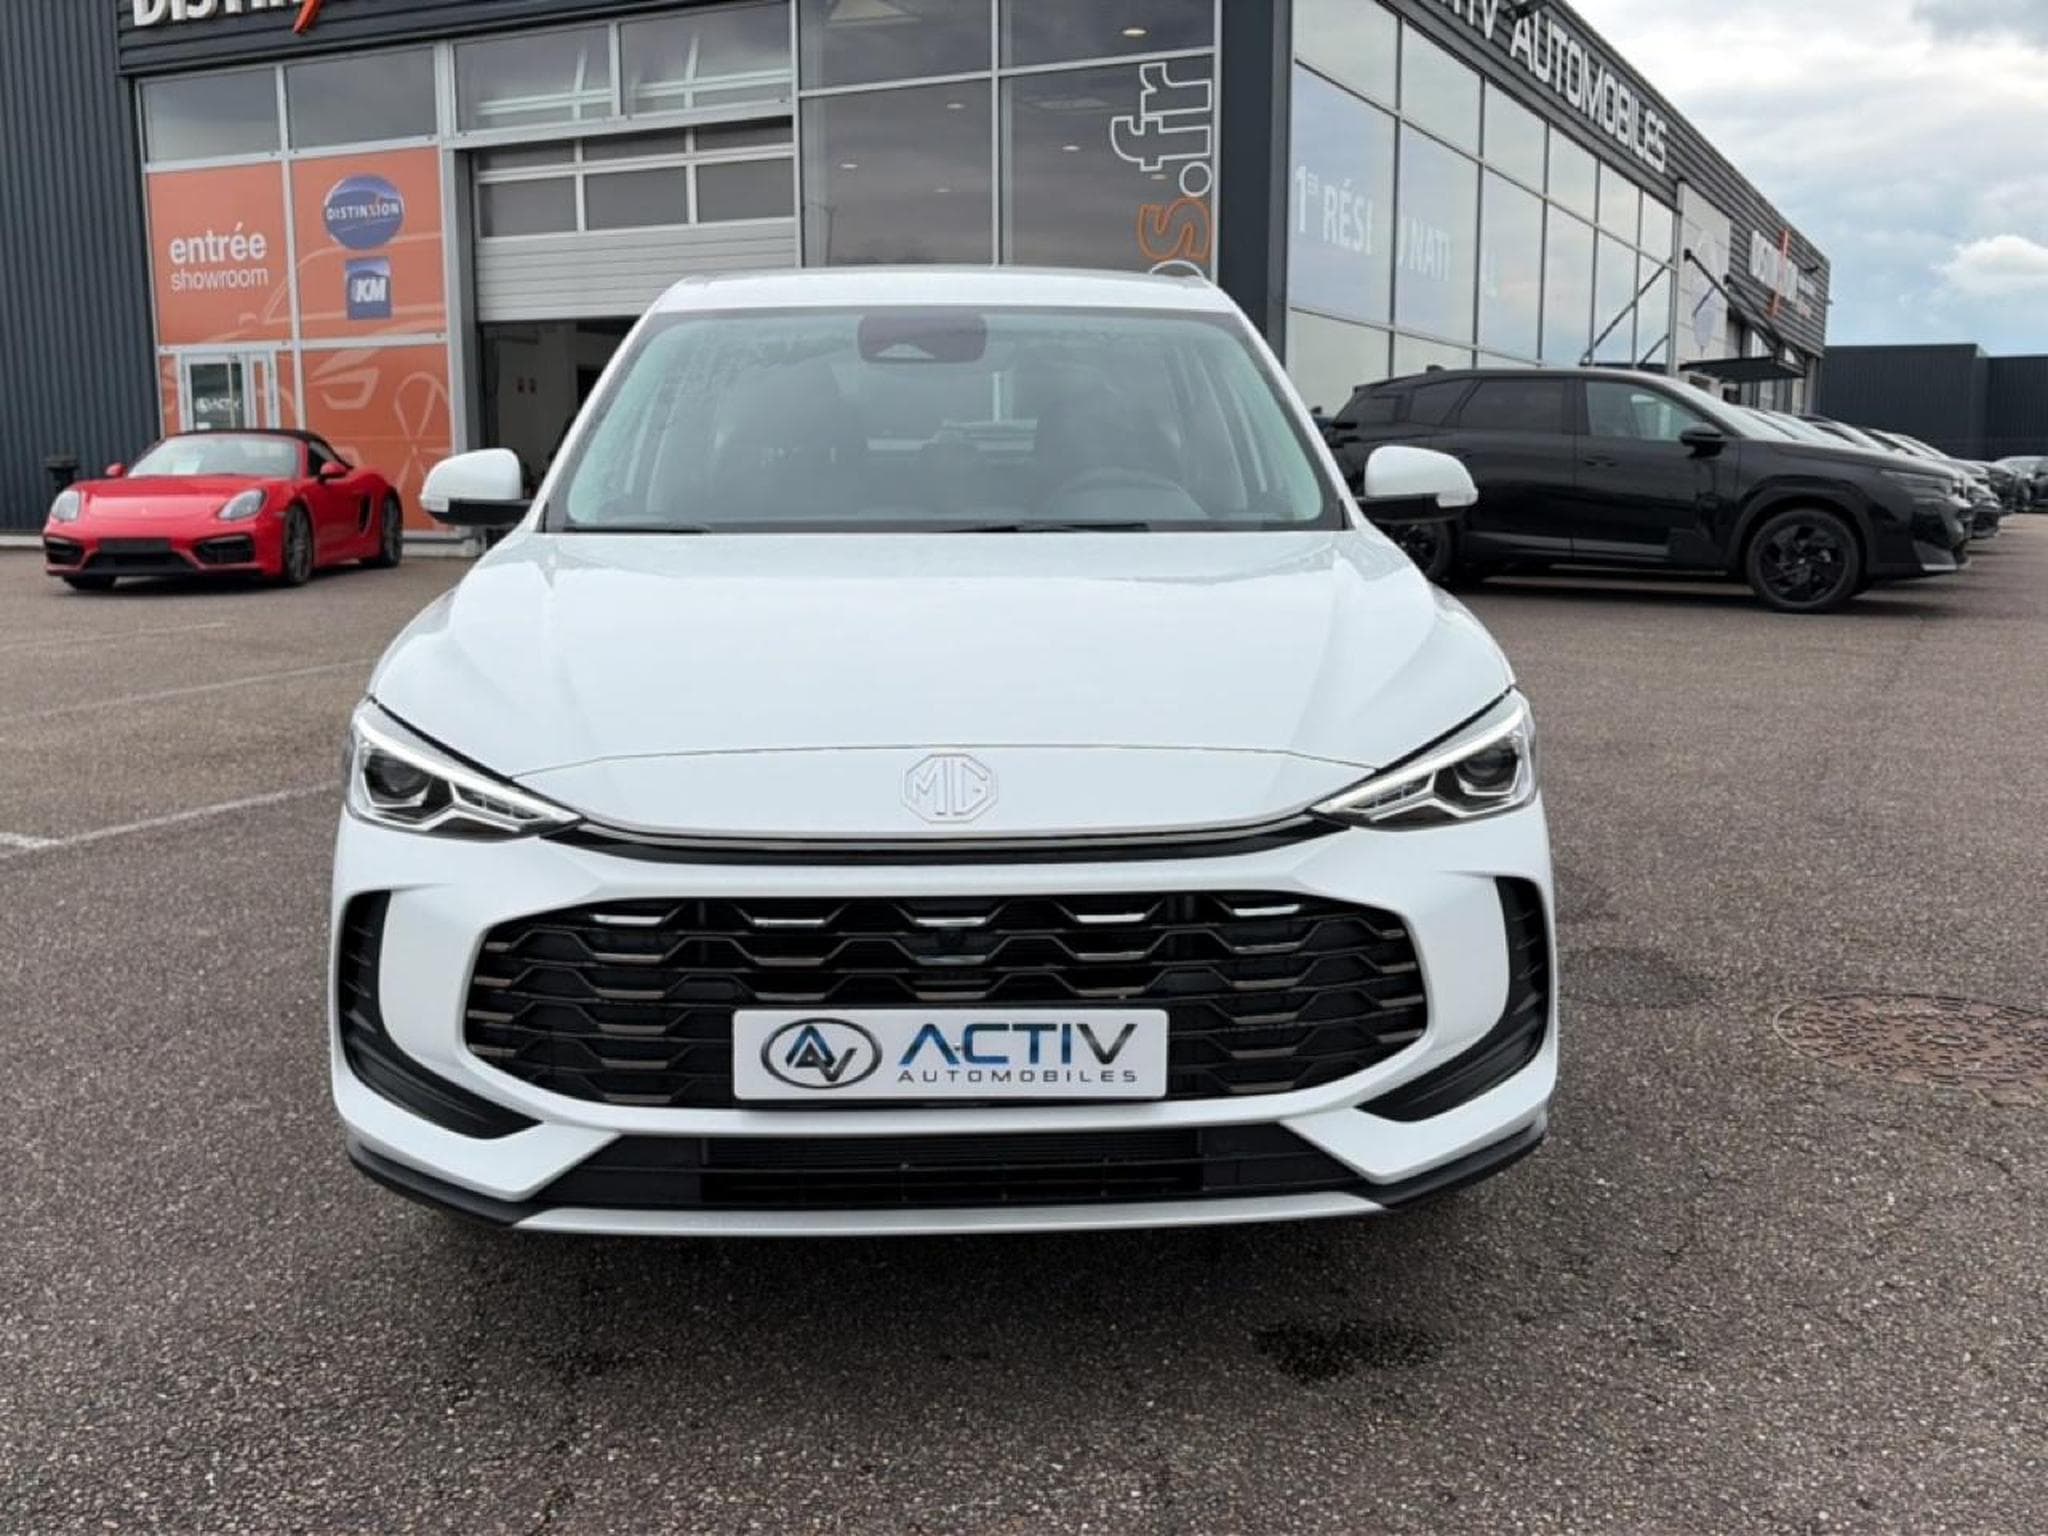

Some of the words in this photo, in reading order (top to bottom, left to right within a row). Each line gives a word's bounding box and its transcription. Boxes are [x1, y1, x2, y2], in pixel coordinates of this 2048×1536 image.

[1510, 10, 1667, 173] AUTOMOBILES
[1111, 62, 1212, 276] s.fr
[170, 221, 267, 264] entrée
[170, 267, 269, 291] showroom
[353, 276, 388, 303] KM
[908, 756, 991, 818] MG
[898, 1023, 1138, 1065] ACTIV
[897, 1069, 1138, 1083] AUTOMOBILES
